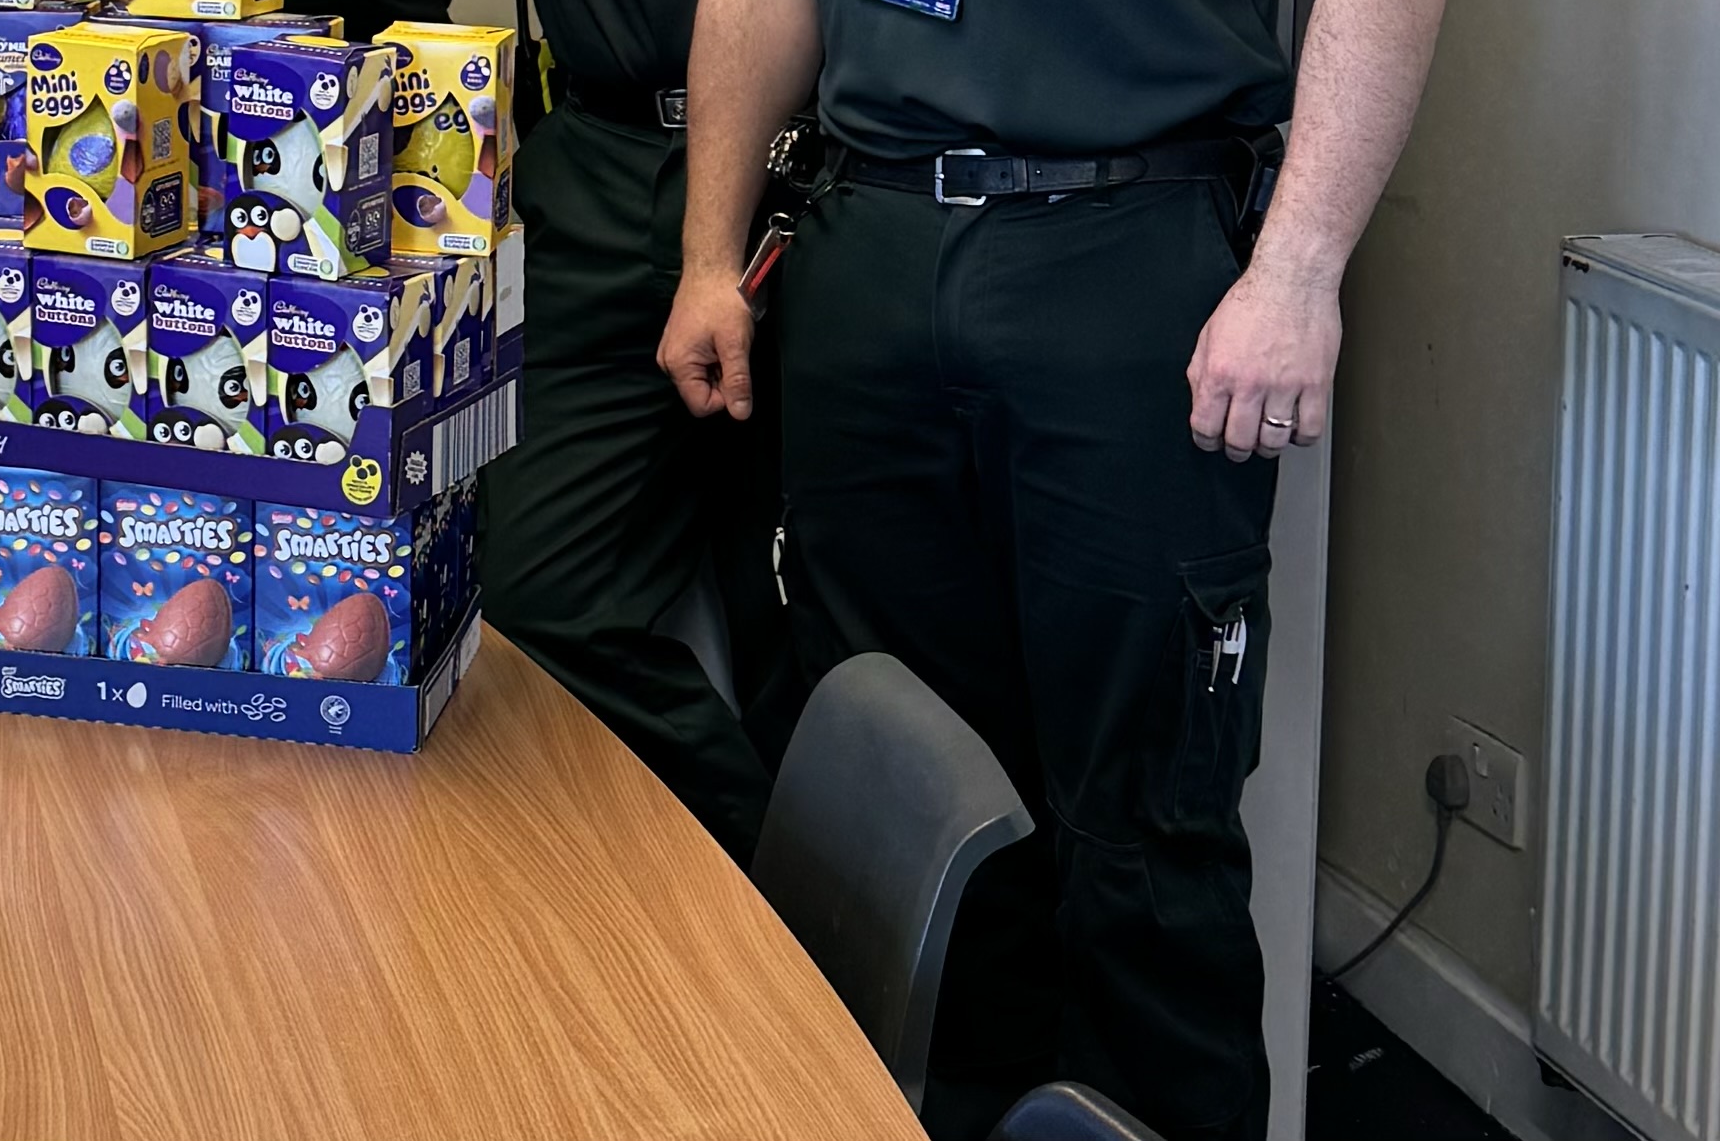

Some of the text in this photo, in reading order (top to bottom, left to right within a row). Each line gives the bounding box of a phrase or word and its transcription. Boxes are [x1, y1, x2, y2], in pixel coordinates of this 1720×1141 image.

[31, 71, 77, 95] Mini
[233, 84, 294, 104] white
[31, 94, 83, 117] eggs
[232, 99, 294, 120] buttons
[36, 293, 96, 312] white
[154, 300, 216, 320] white
[36, 308, 96, 326] buttons
[153, 315, 216, 336] buttons
[273, 315, 336, 335] white
[272, 330, 336, 352] buttons
[161, 695, 238, 715] Filled with
